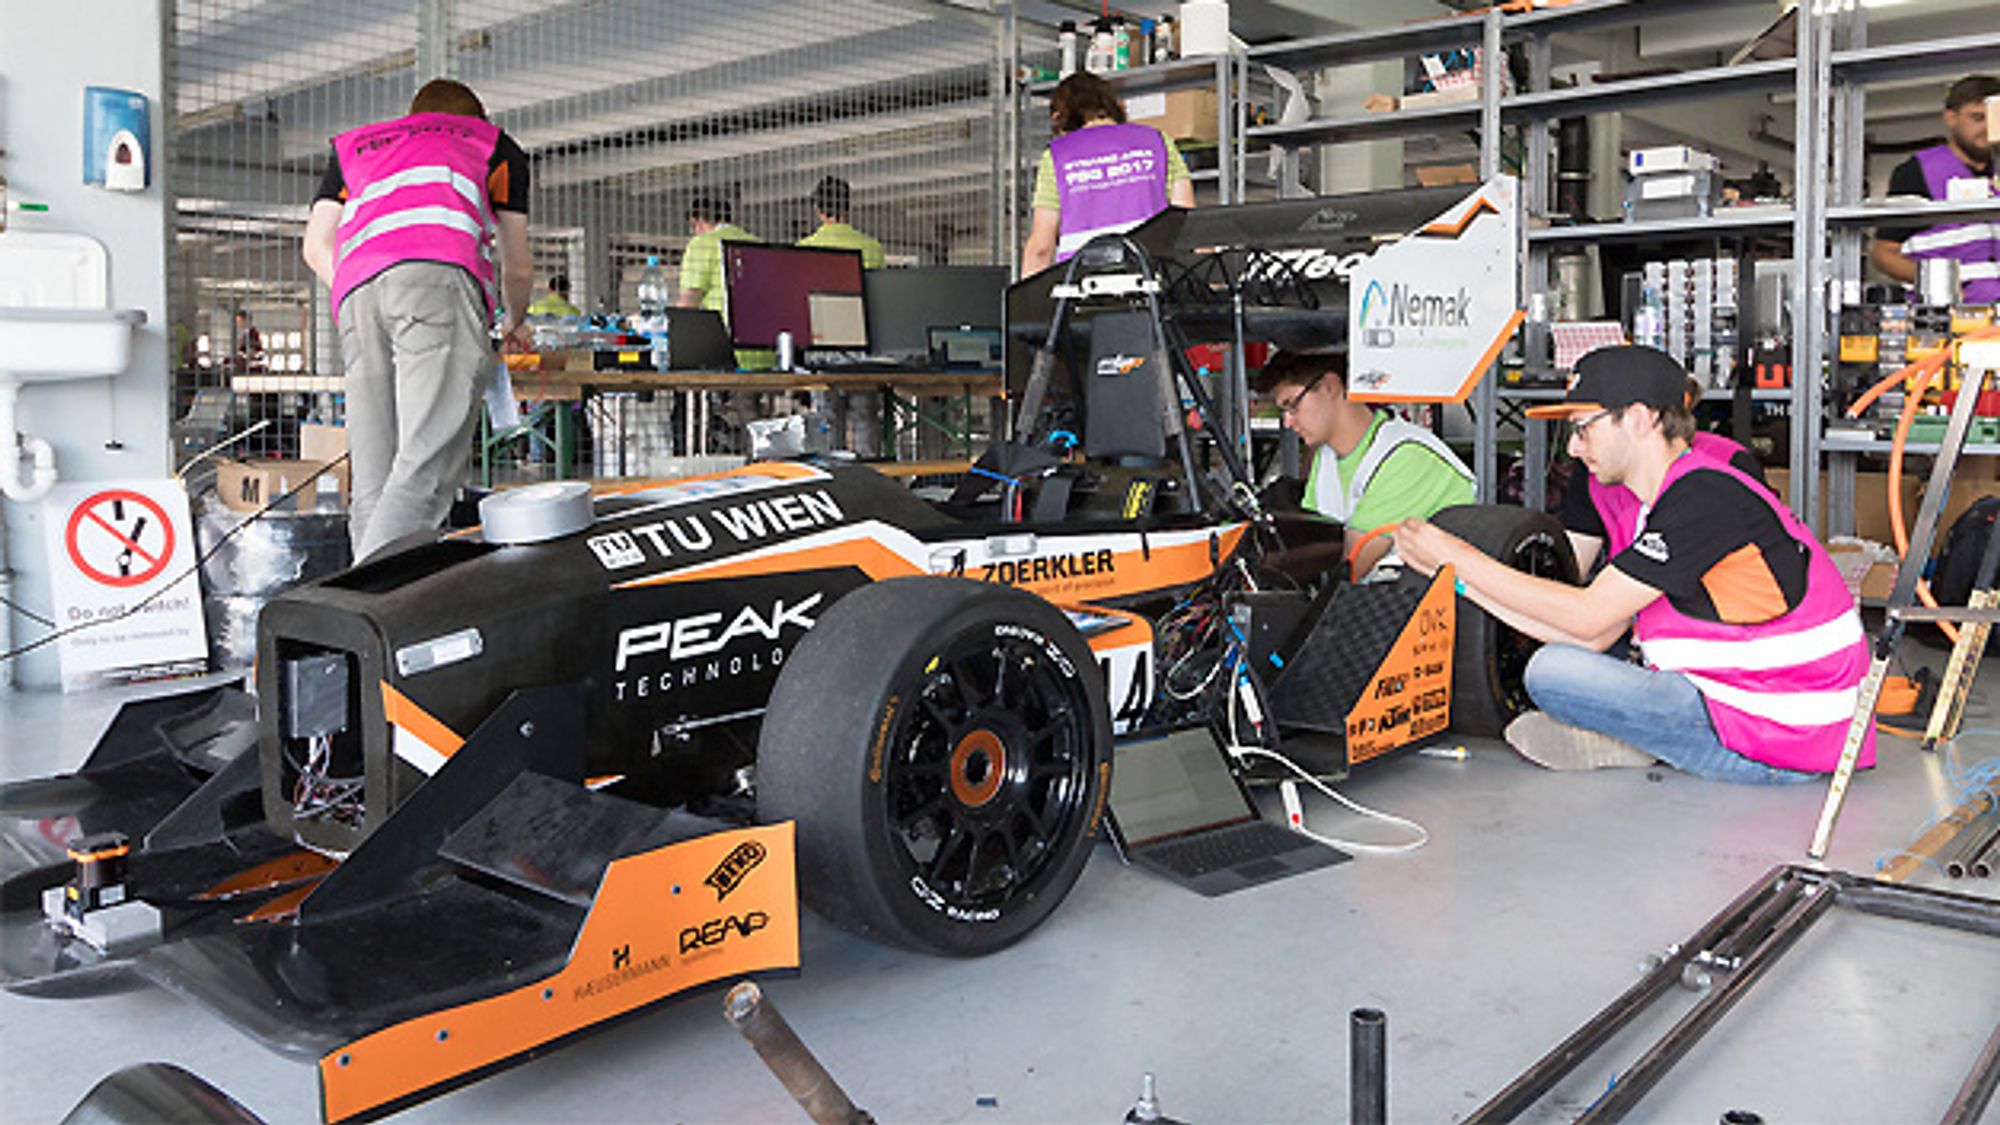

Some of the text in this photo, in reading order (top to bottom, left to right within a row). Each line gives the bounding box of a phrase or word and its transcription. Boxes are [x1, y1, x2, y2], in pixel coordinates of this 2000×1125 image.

[1106, 158, 1153, 178] 2017
[1390, 282, 1471, 327] Nemak
[242, 475, 260, 504] M
[632, 490, 844, 557] TU WIEN
[981, 548, 1115, 586] ZOERKLER
[67, 606, 94, 620] Do
[615, 592, 823, 672] PEAK
